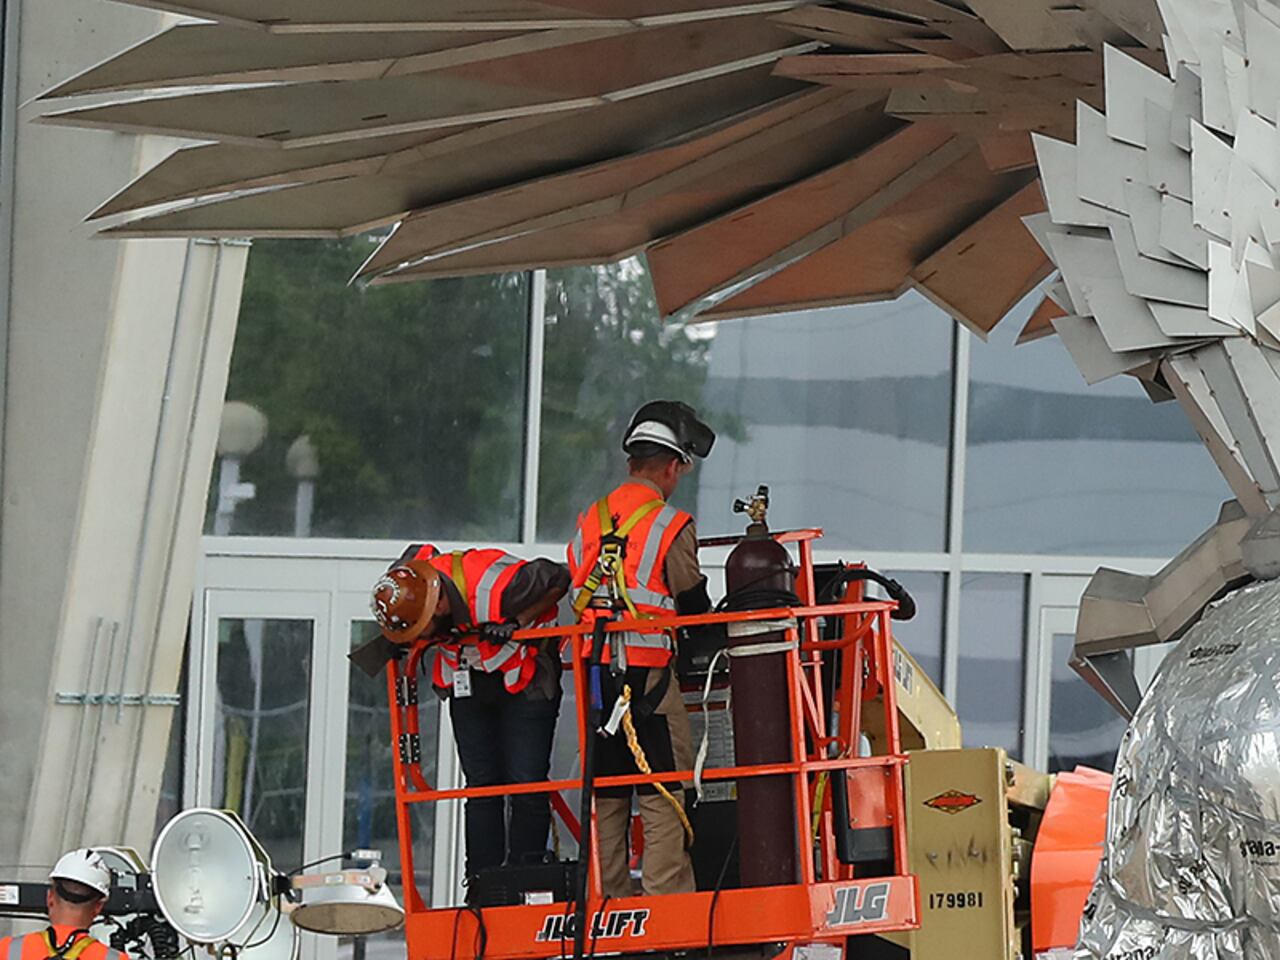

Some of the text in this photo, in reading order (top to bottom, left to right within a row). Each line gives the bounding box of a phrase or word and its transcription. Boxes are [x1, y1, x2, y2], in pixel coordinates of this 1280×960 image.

[827, 882, 890, 927] JLG
[929, 892, 983, 910] 179981
[588, 909, 650, 939] LIFT
